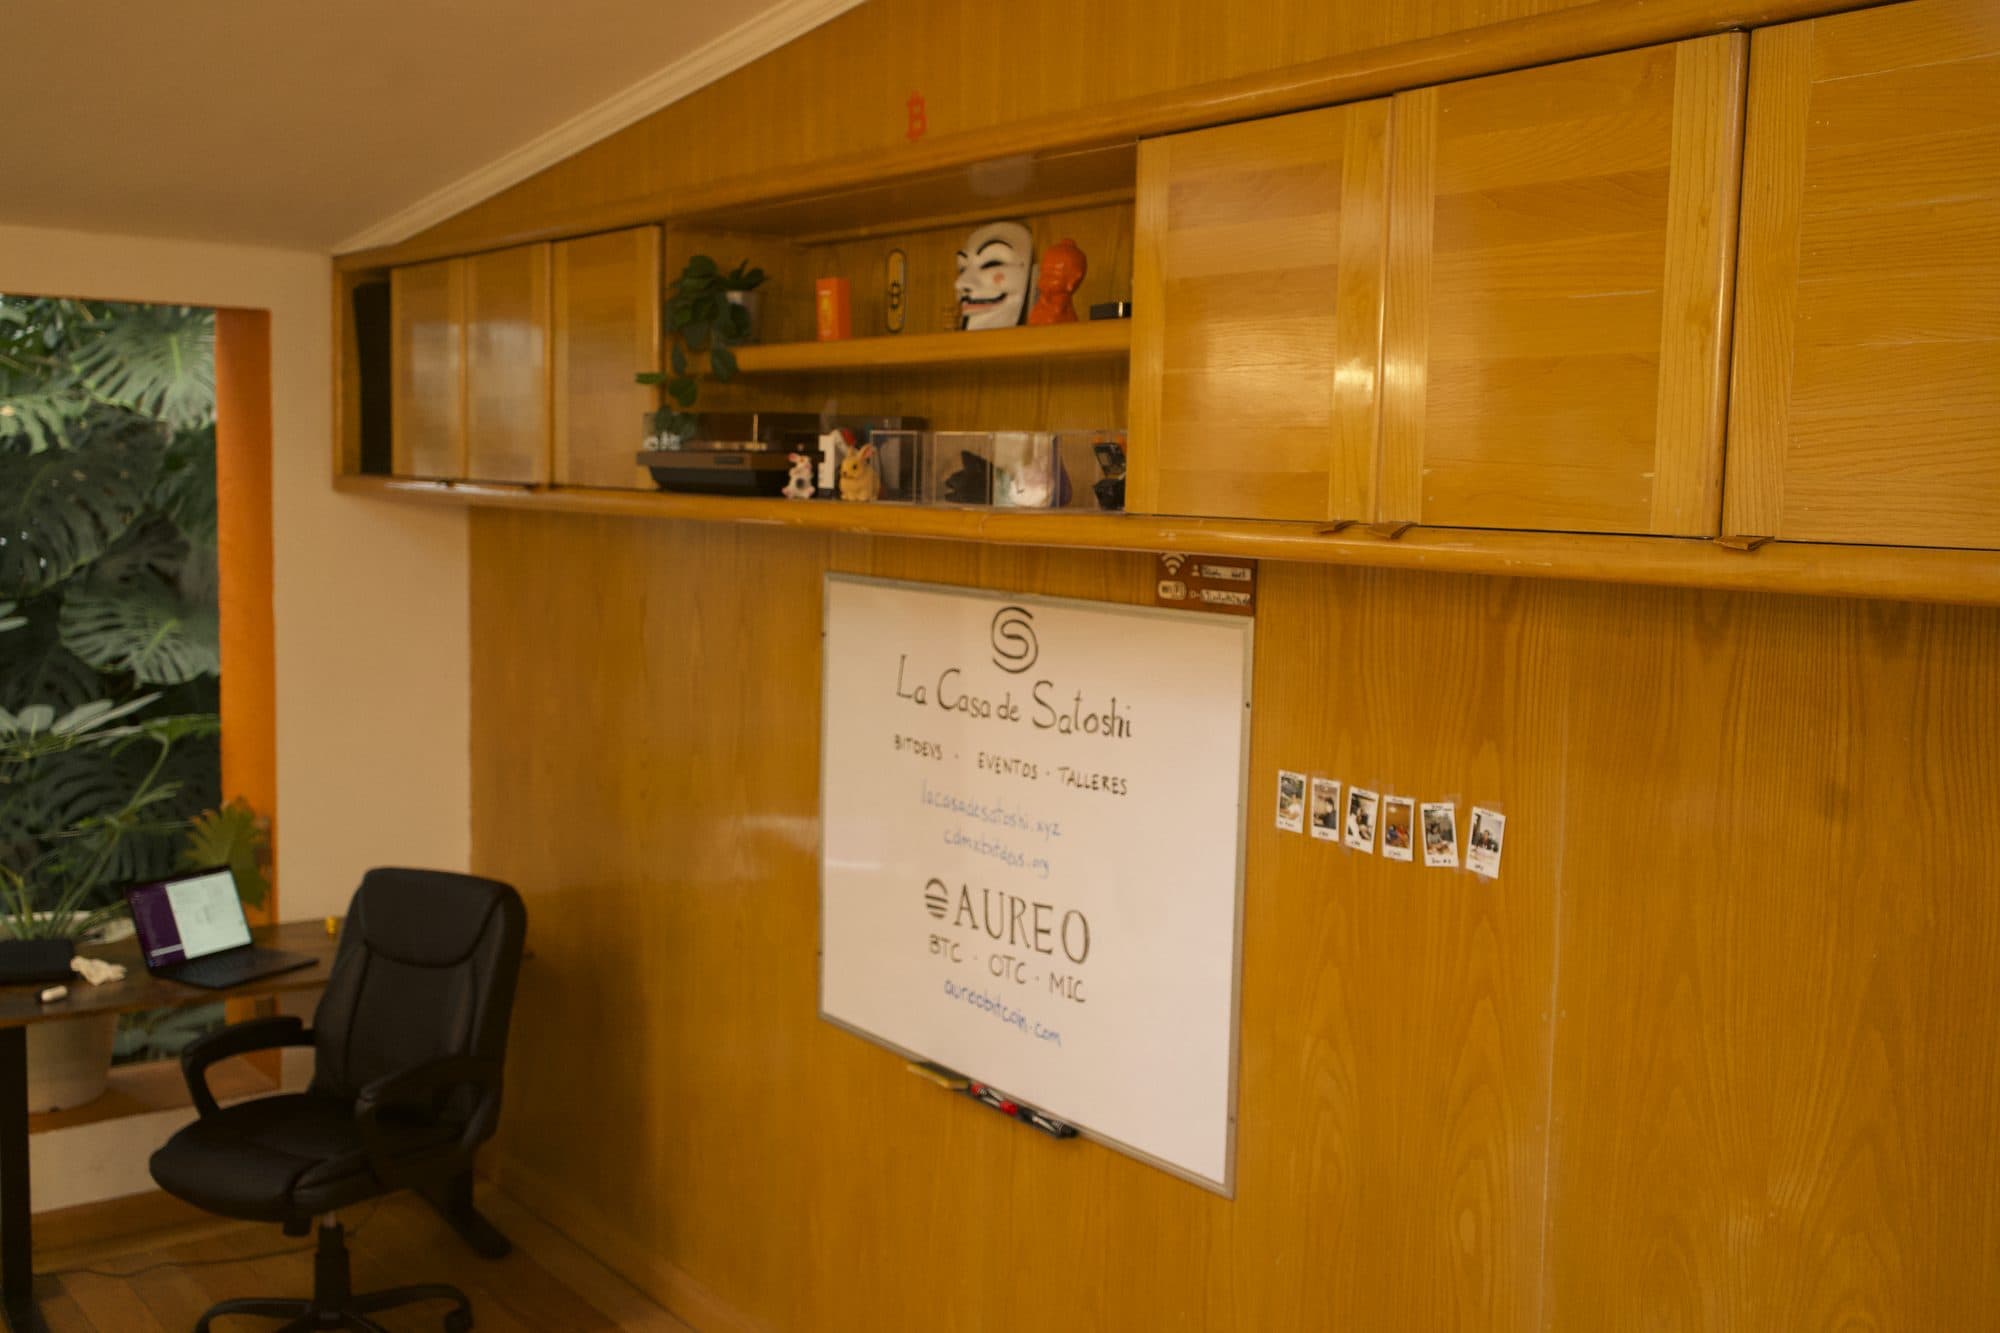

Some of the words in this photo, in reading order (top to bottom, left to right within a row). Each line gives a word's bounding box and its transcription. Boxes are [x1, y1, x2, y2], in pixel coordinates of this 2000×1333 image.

[896, 653, 928, 706] La
[937, 667, 992, 719] Casa
[996, 691, 1021, 723] de
[1032, 680, 1133, 740] Satoshi
[977, 751, 1038, 780] EVENTOS
[1056, 765, 1129, 796] TALLERES
[953, 882, 1091, 966] AUREO
[929, 933, 963, 964] BTC
[988, 953, 1027, 985] OTC
[1048, 971, 1087, 1004] MIC
[943, 978, 1062, 1048] aureobitcoin.com
